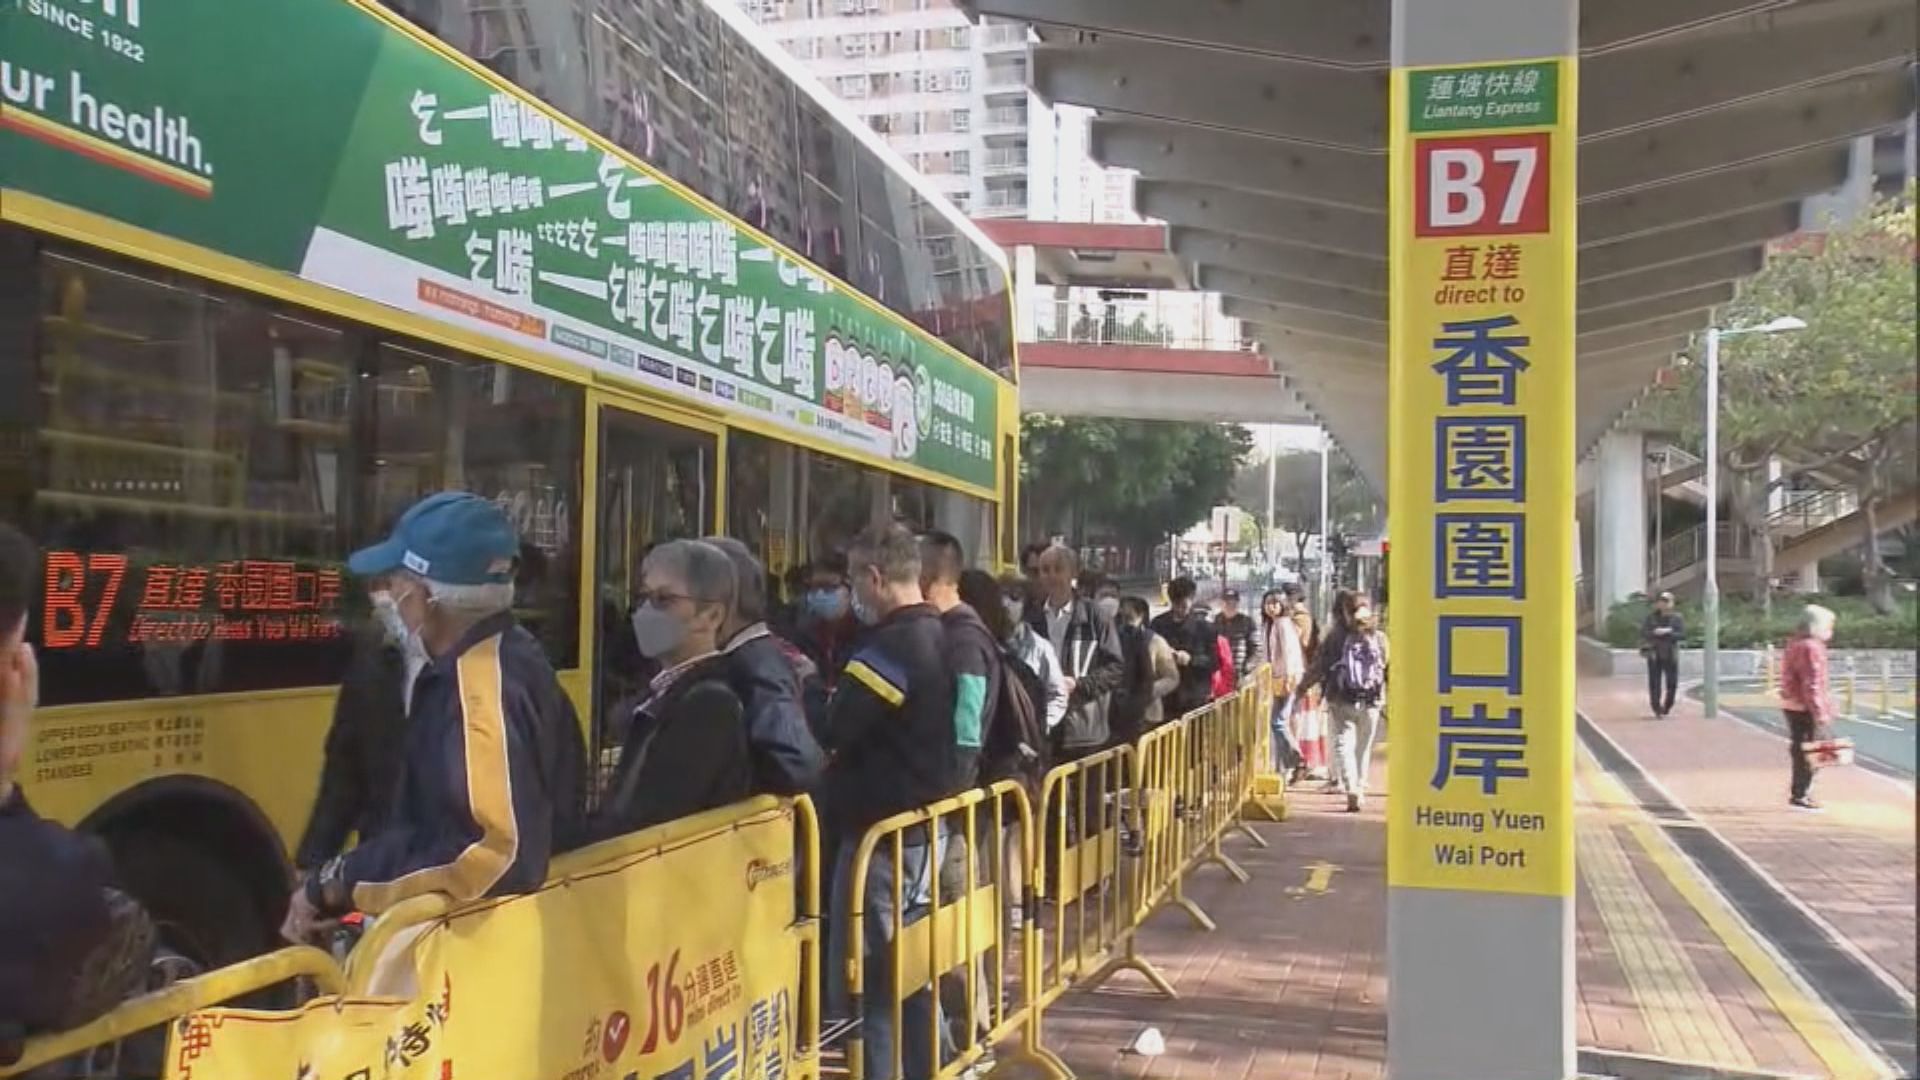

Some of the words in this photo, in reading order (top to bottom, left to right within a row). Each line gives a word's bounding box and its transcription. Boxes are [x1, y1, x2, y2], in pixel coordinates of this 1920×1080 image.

[28, 0, 93, 39] SINCE
[101, 30, 145, 63] 1922
[1423, 102, 1482, 120] Liantang
[1485, 99, 1541, 117] Express
[1427, 69, 1539, 100] 蓮塘快線
[71, 70, 213, 175] health.
[1429, 147, 1538, 228] B7
[1440, 243, 1522, 282] 直達
[1434, 285, 1497, 306] direct
[1504, 286, 1524, 304] to
[1431, 314, 1530, 795] 香園圍口岸
[44, 551, 128, 648] B7
[1416, 805, 1484, 833] Heung
[1490, 808, 1545, 831] Yuen
[1434, 843, 1474, 866] Wai
[1480, 845, 1526, 868] Port
[639, 948, 684, 1055] 16
